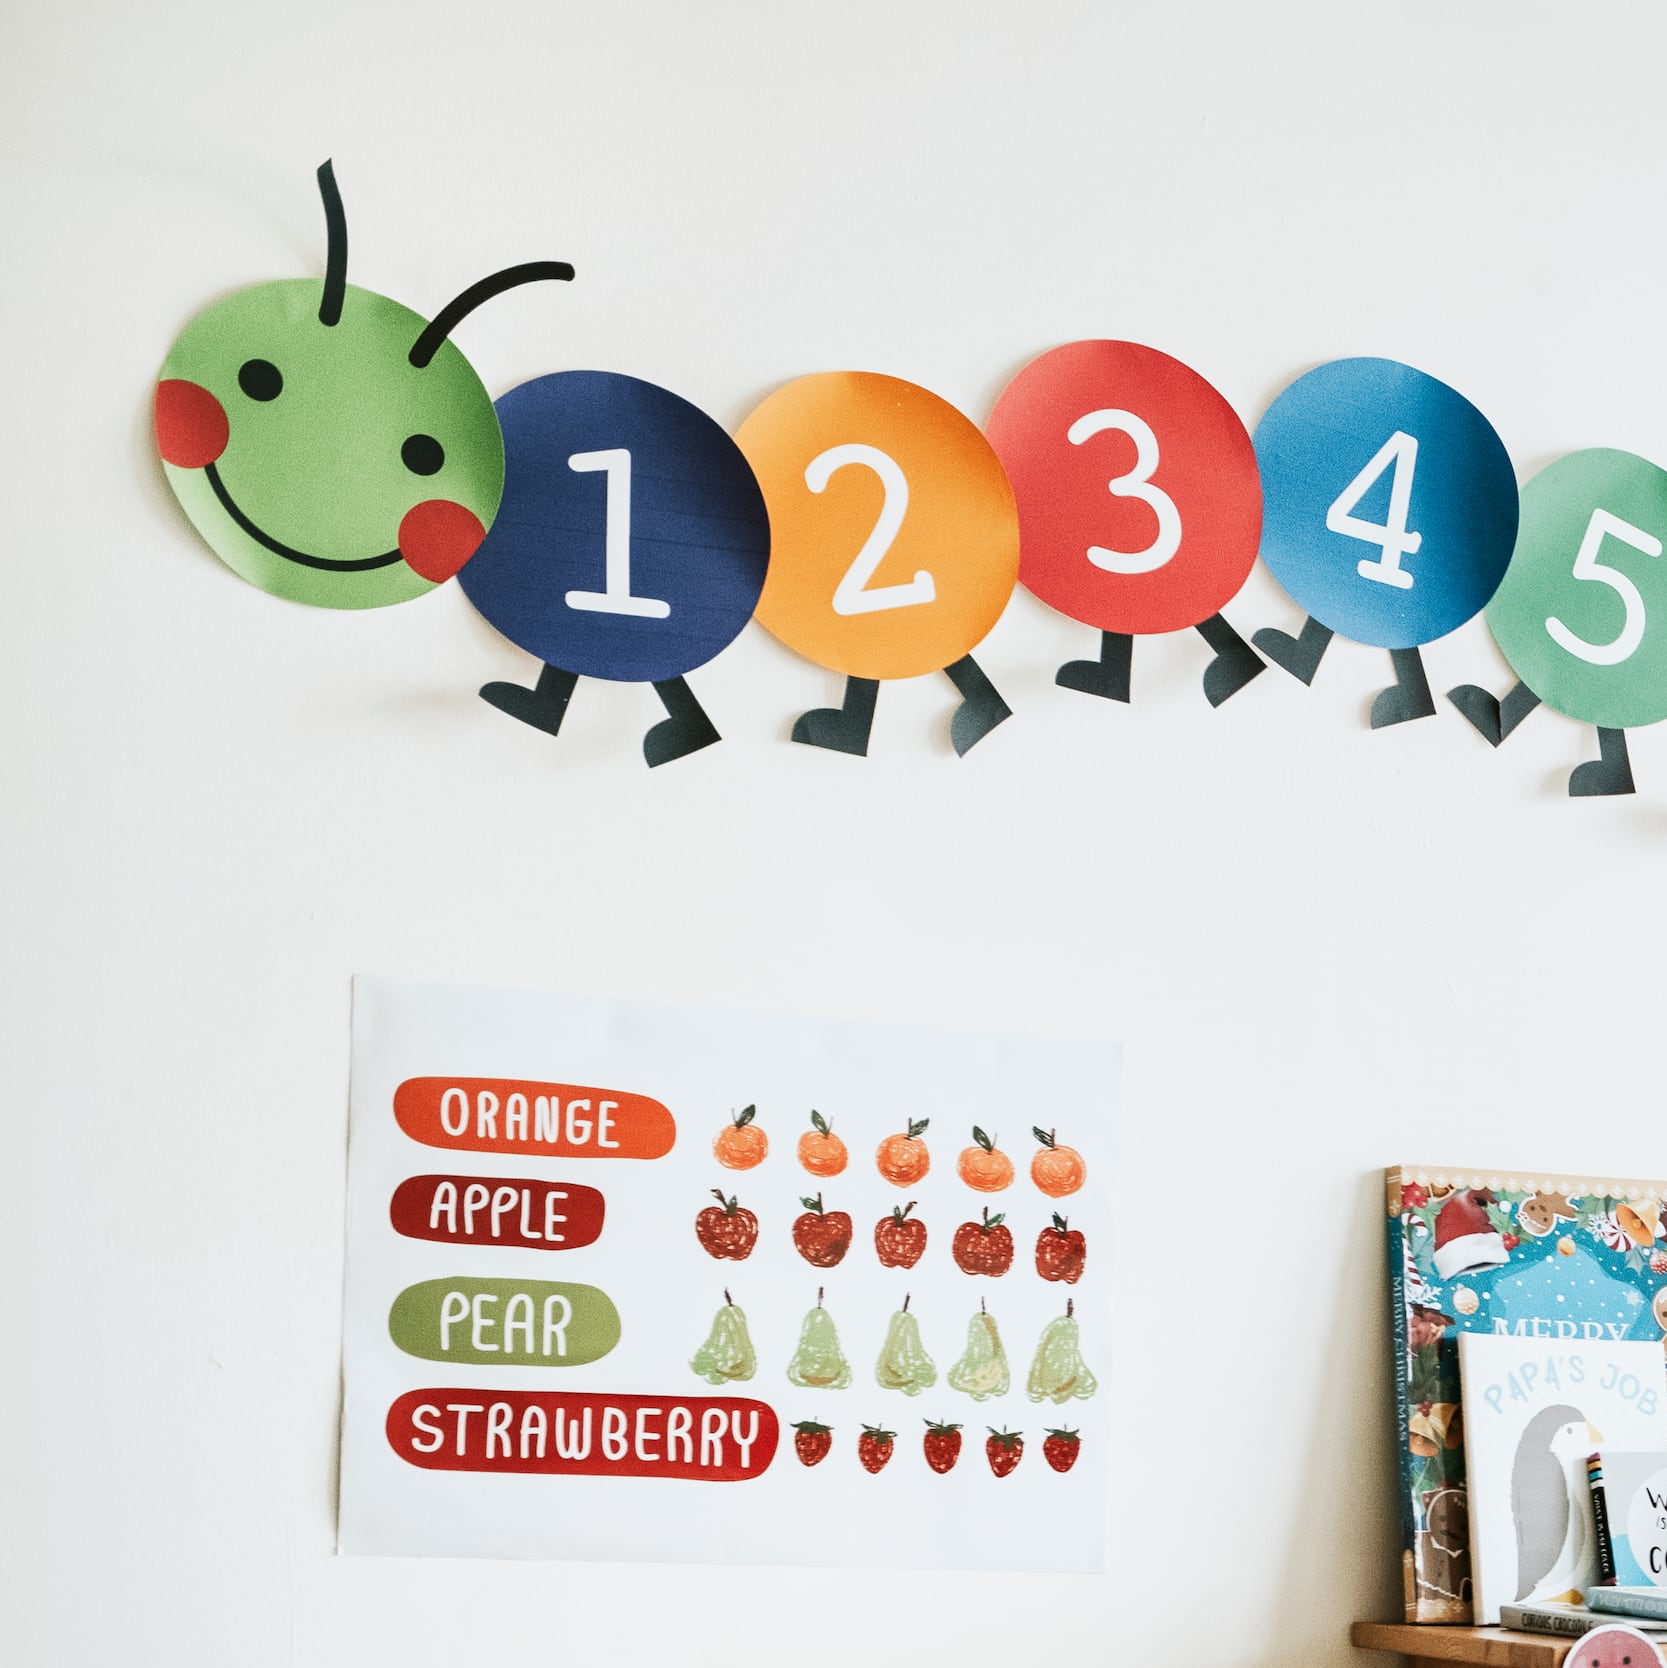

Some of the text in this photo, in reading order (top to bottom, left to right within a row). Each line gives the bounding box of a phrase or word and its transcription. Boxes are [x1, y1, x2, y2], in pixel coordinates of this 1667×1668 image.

[565, 448, 671, 620] 1
[804, 442, 936, 616] 2
[1067, 408, 1183, 575] 3
[1326, 429, 1423, 590] 4
[1545, 508, 1663, 665] 5
[440, 1087, 620, 1149] ORANGE
[429, 1182, 569, 1242] APPLE
[440, 1291, 572, 1357] PEAR
[1483, 1355, 1659, 1416] PAPA'S JOB
[410, 1403, 760, 1469] STRAWBERRY
